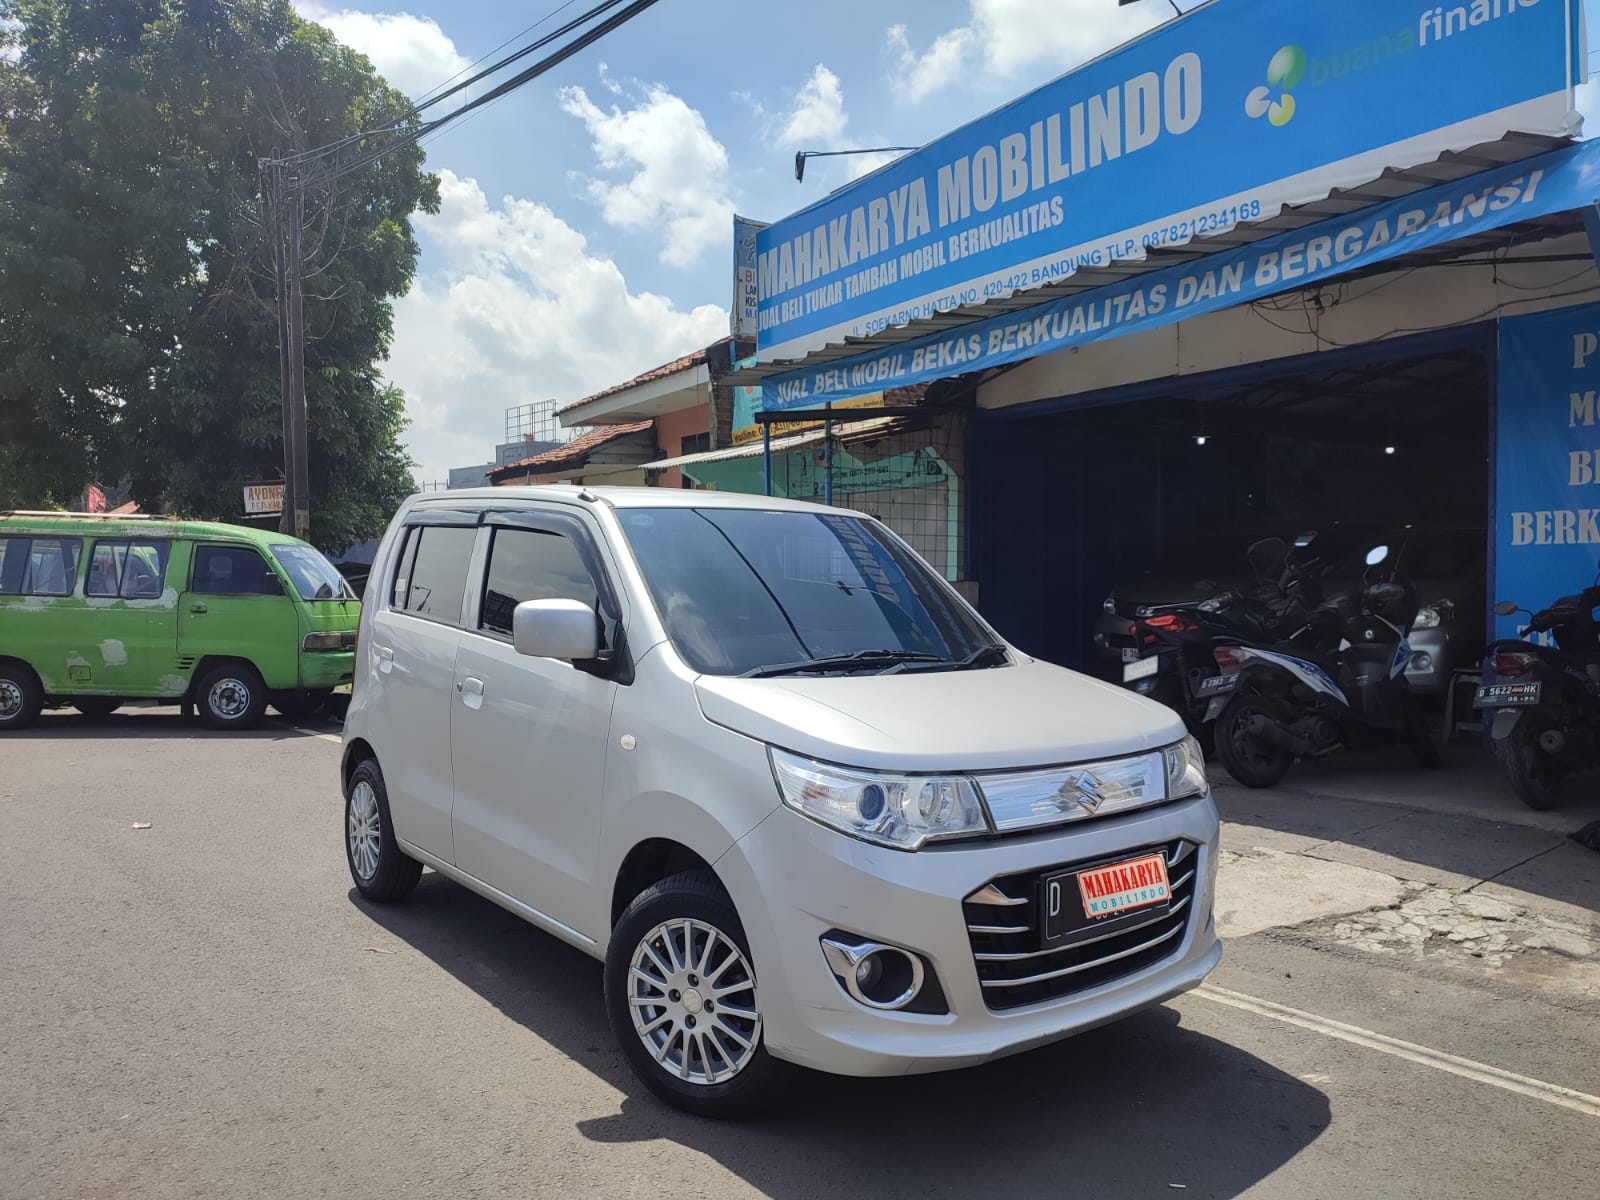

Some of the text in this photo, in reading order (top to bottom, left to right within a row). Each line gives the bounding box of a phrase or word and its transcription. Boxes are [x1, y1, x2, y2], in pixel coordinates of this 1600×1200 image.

[1311, 27, 1416, 86] buana
[758, 52, 1202, 302] MAHAKARYA MOBILINDO
[759, 195, 1064, 332] JUAL BELI TUKAR TAMBAH MOBIL BERKUALITAS
[777, 169, 1544, 404] JUAL BELI MOBIL BEKAS BERKUALITAS DAN BERGARANSI
[866, 305, 919, 333] SOEKARNO
[923, 294, 957, 317] HATTA
[960, 288, 979, 304] NO.
[983, 272, 1027, 298] 420-422
[1032, 249, 1102, 283] BANDUNG
[1106, 239, 1137, 259] TLP.
[1142, 200, 1260, 248] 087821234168
[1569, 390, 1600, 427] M
[1489, 686, 1512, 696] 5622
[1524, 685, 1536, 694] HK
[1050, 882, 1060, 917] D
[1083, 861, 1163, 899] MAHAKARYA
[1090, 886, 1165, 913] MOBILINDO
